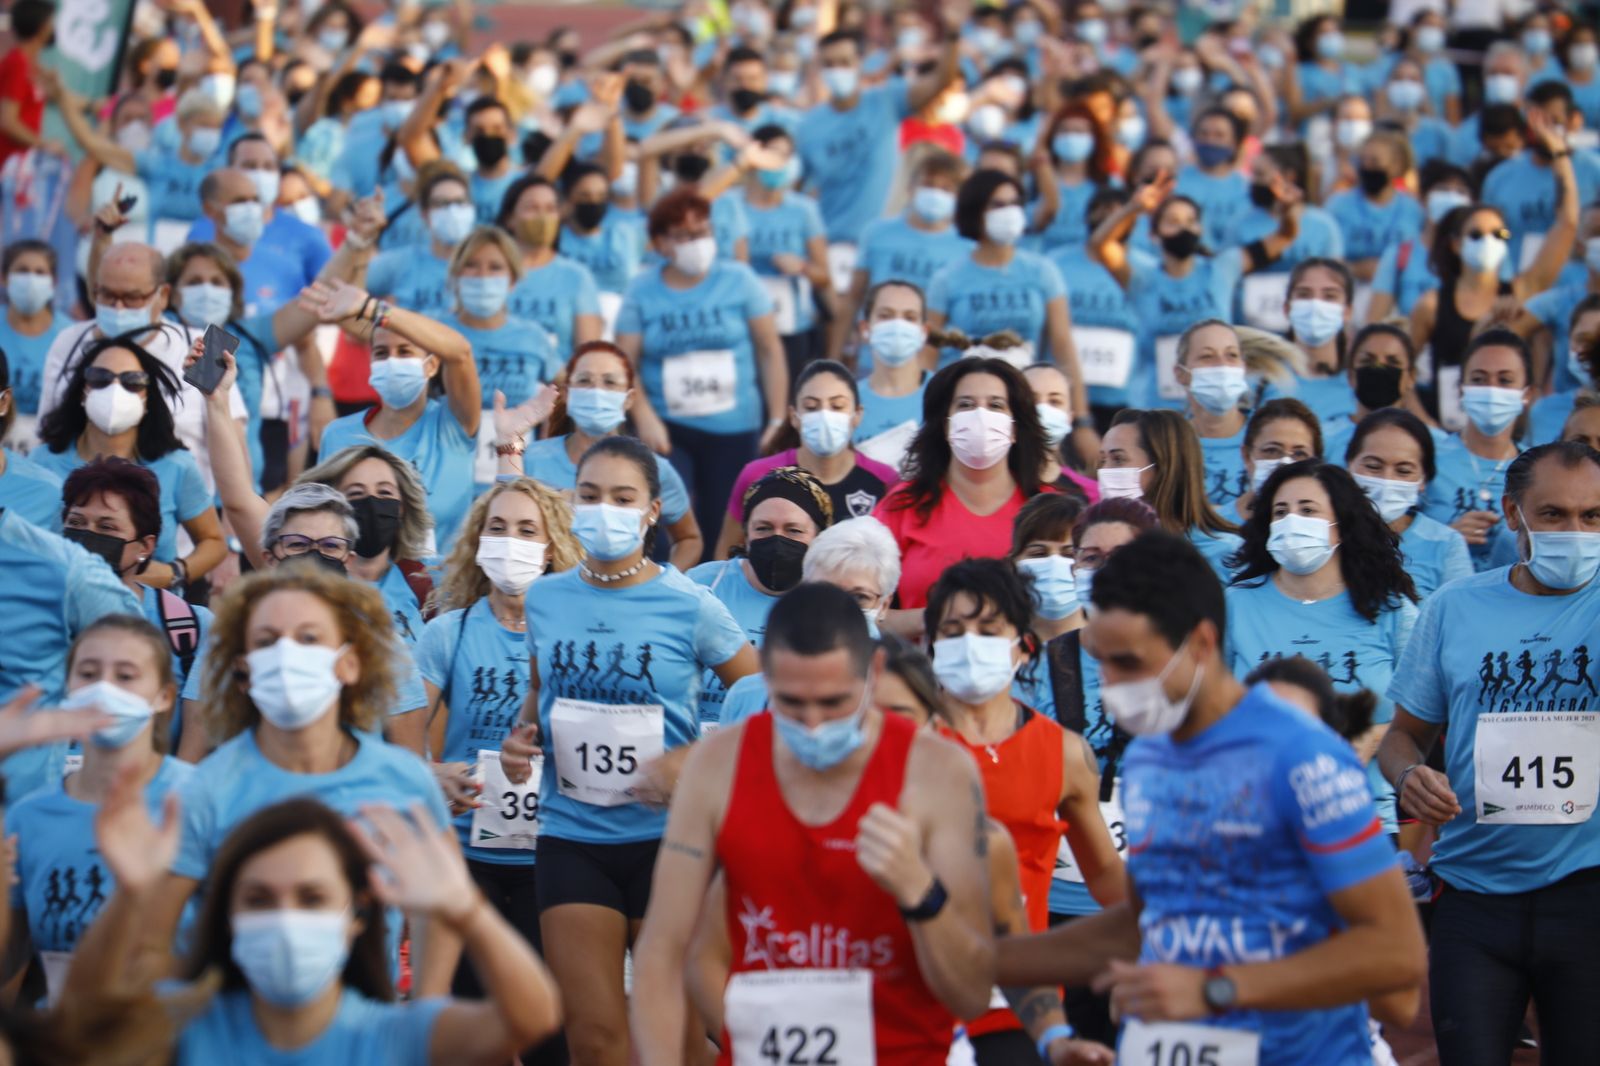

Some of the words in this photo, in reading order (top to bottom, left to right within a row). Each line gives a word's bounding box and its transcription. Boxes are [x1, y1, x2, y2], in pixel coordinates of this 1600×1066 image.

[575, 742, 638, 775] 135
[1501, 755, 1575, 789] 415
[500, 791, 540, 821] 39
[767, 922, 894, 969] califas
[760, 1025, 839, 1066] 422
[1146, 1041, 1220, 1066] 105
